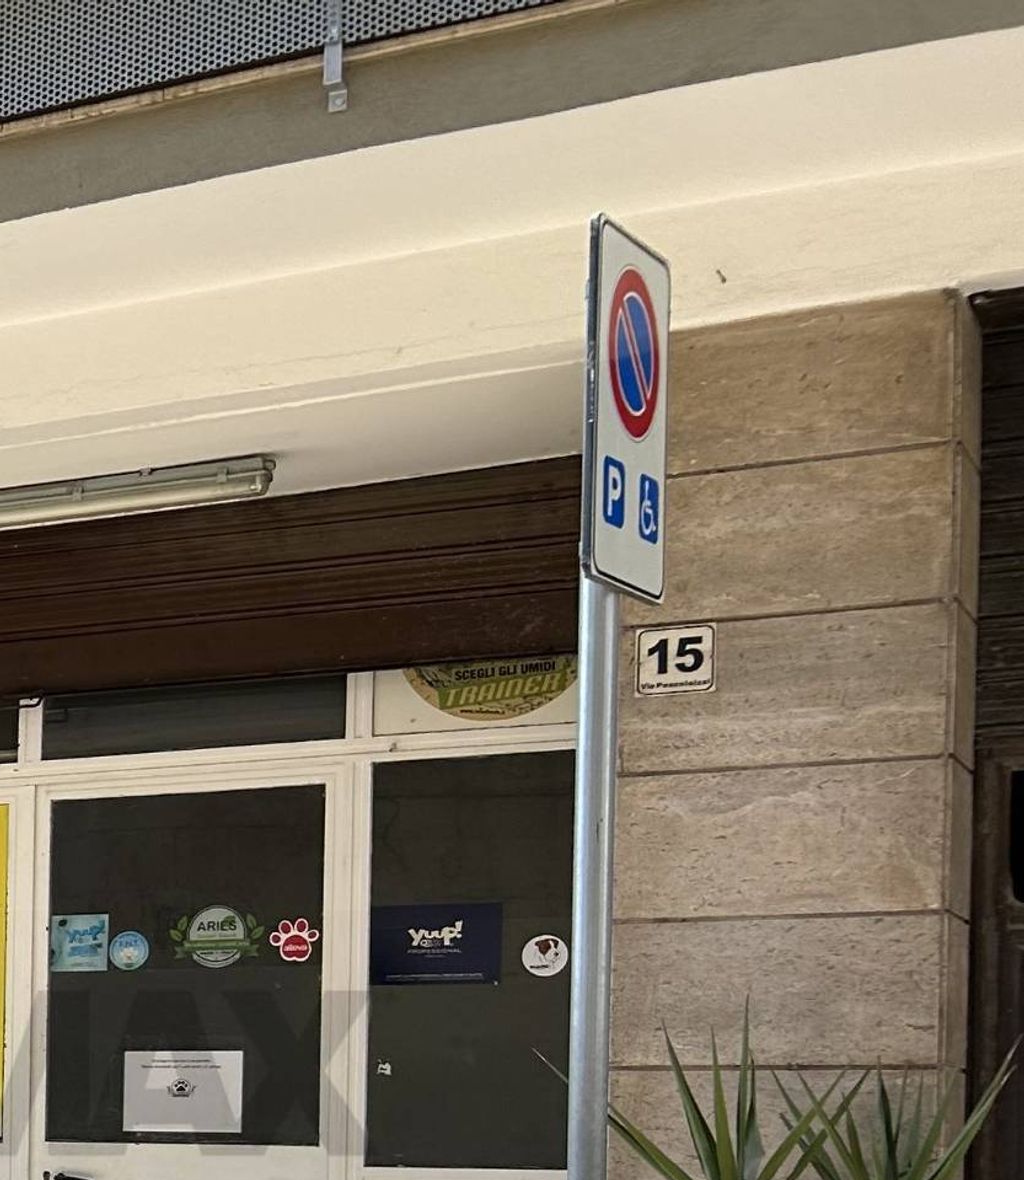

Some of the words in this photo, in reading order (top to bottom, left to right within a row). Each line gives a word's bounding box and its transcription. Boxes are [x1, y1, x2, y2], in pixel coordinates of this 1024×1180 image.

[607, 463, 622, 517] P
[454, 668, 496, 681] SCEGLI
[498, 665, 517, 677] GLI
[520, 660, 557, 675] UMIDI
[647, 635, 705, 675] 15
[445, 672, 563, 707] TRAINER
[196, 919, 237, 932] ARIES
[407, 919, 464, 947] yuup!
